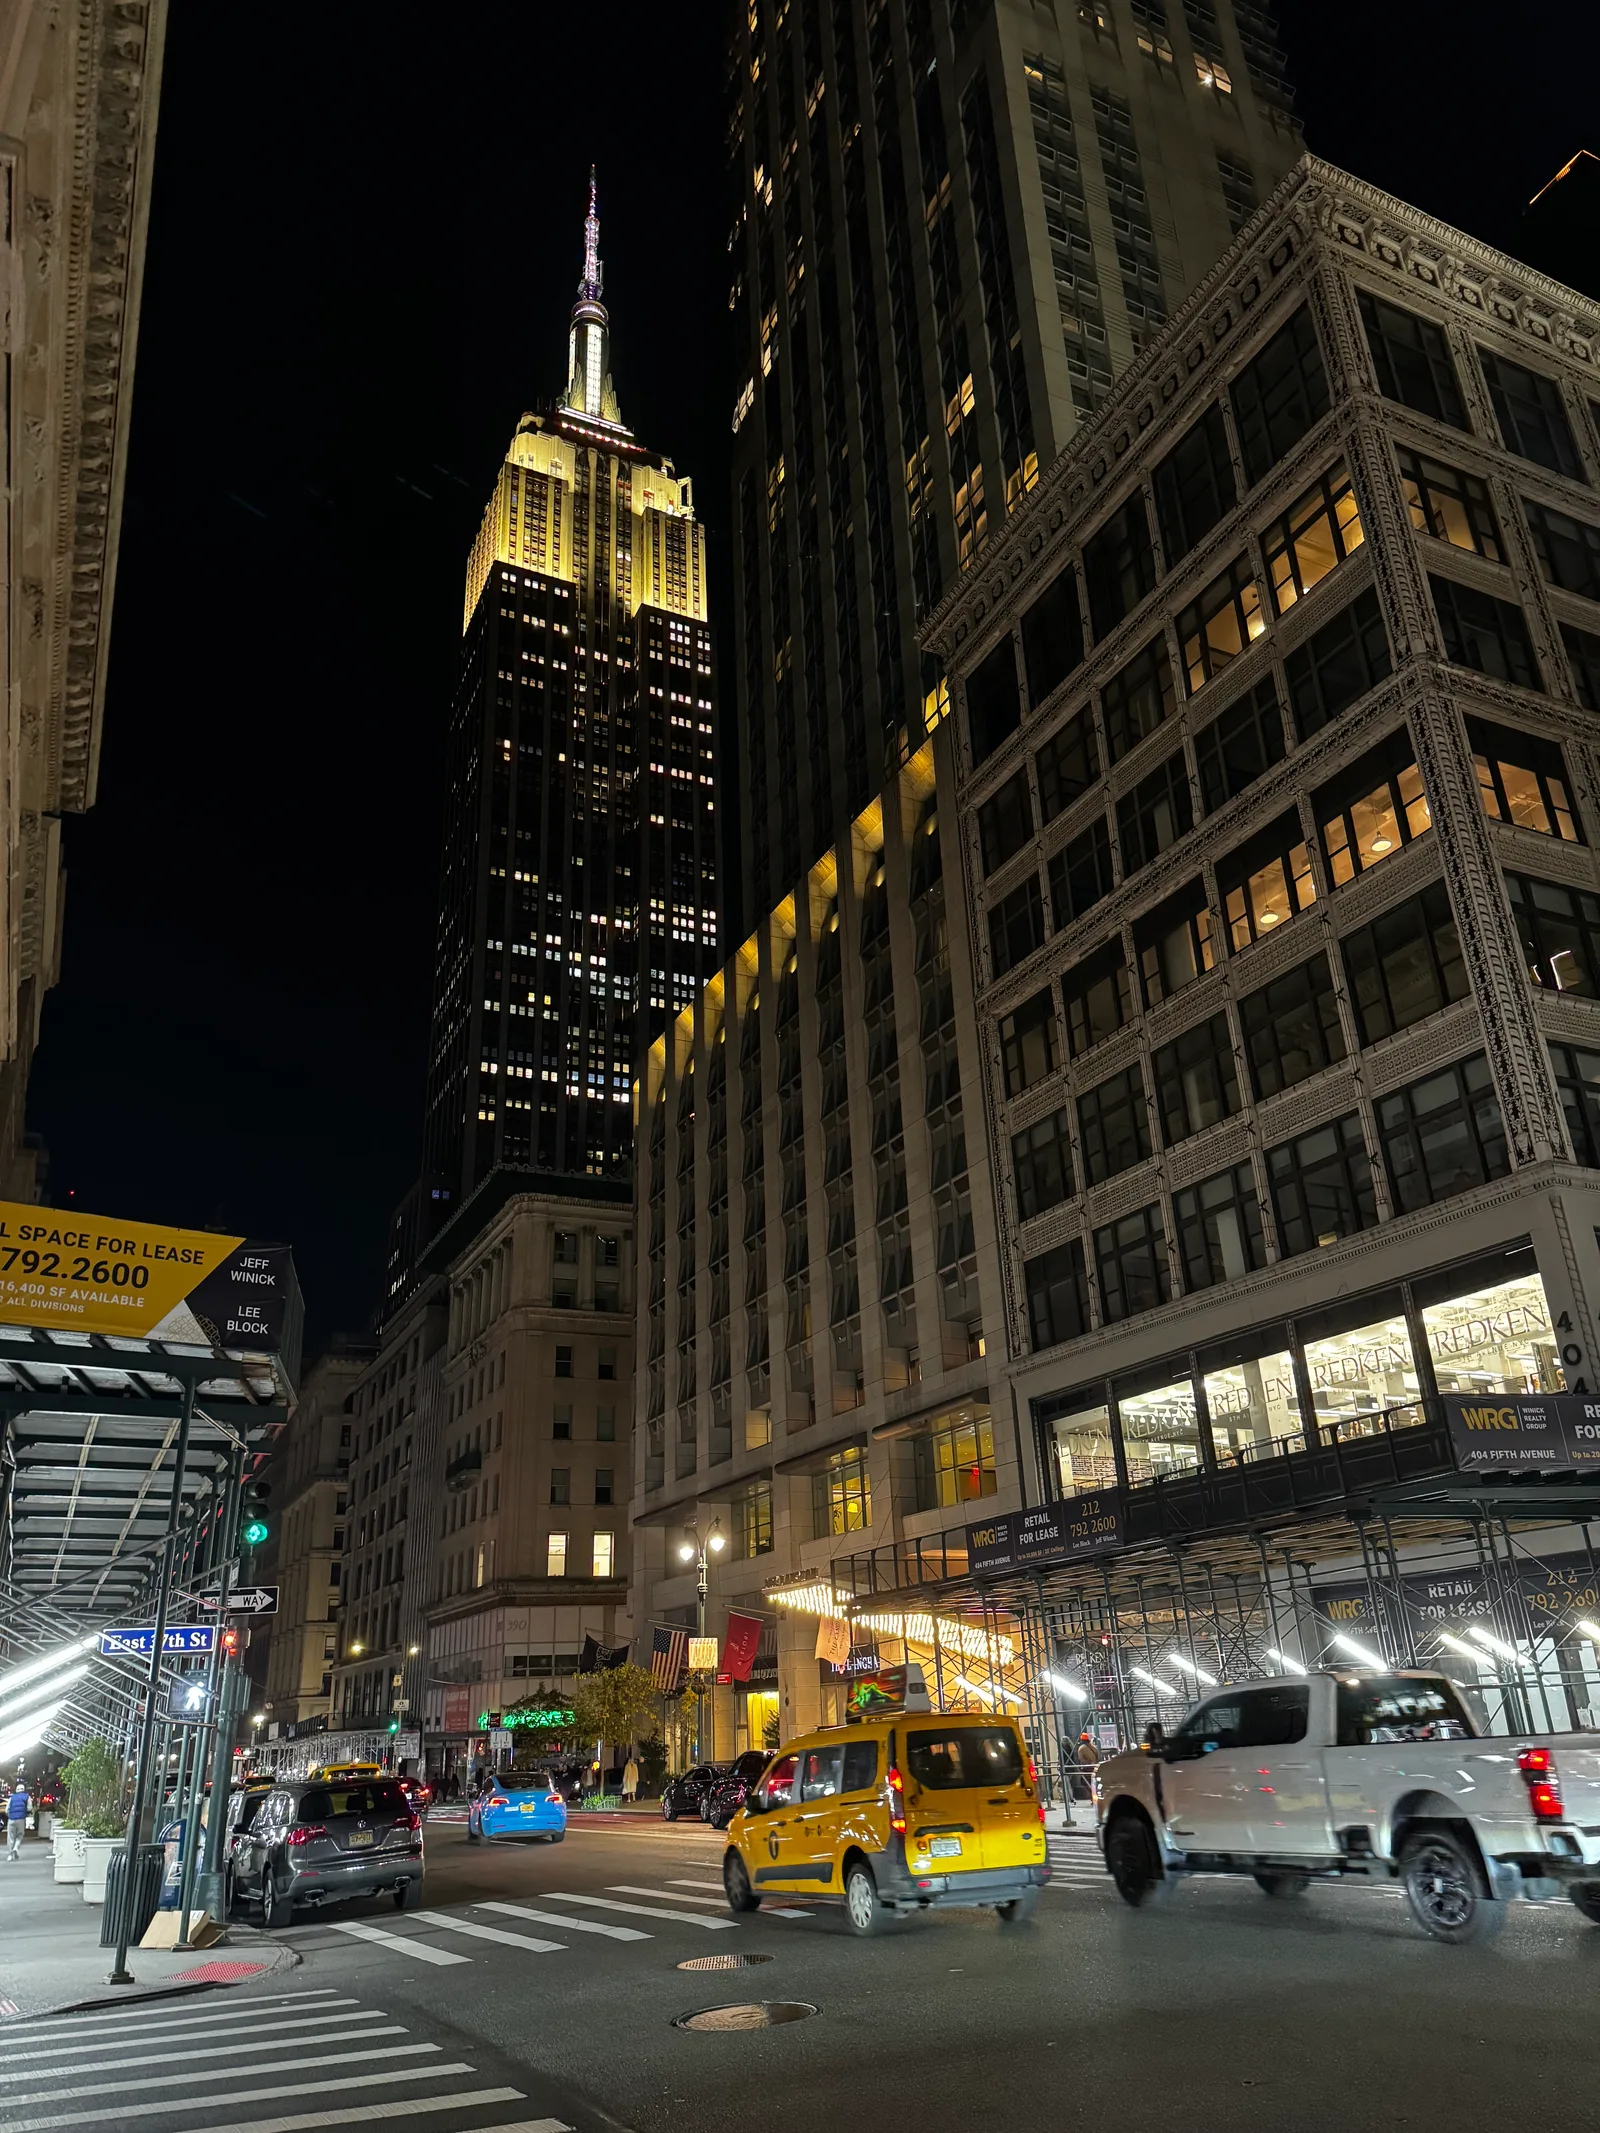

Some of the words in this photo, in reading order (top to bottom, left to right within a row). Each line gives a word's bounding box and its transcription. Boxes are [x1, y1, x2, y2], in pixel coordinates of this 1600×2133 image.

[18, 1225, 91, 1249] SPACE
[96, 1236, 136, 1255] FOR
[142, 1243, 205, 1265] LEASE
[1, 1247, 149, 1288] 792.2600
[240, 1256, 269, 1270] JEFF
[230, 1270, 276, 1286] WINICK
[0, 1281, 45, 1295] 16,400
[49, 1286, 66, 1297] SF
[70, 1289, 144, 1307] AVAILABLE
[7, 1297, 26, 1306] ALL
[30, 1299, 84, 1313] DIVISIONS
[238, 1306, 261, 1318] LEE
[227, 1320, 269, 1334] BLOCK
[1433, 1302, 1547, 1356] REDKEN
[1314, 1342, 1408, 1389] REDKEN
[1213, 1374, 1293, 1416] REDKEN
[1461, 1407, 1519, 1430] WRG
[1050, 1425, 1110, 1460] REDKEN
[1471, 1451, 1488, 1460] 404
[1490, 1450, 1517, 1459] FIFTH
[1520, 1450, 1556, 1459] AVENUE
[1572, 1451, 1582, 1459] Up
[1081, 1500, 1100, 1517] 212
[1024, 1512, 1050, 1528] RETAIL
[1070, 1522, 1088, 1537] 792
[1091, 1515, 1116, 1533] 2600
[972, 1528, 995, 1548] WRG
[1019, 1532, 1034, 1546] FOR
[1035, 1527, 1059, 1540] LEASE
[1428, 1580, 1477, 1598] RETAIL
[211, 1597, 233, 1607] OE
[243, 1595, 266, 1607] WAY
[1326, 1598, 1366, 1620] WRG
[1527, 1593, 1559, 1611] 792
[1420, 1605, 1446, 1620] FOR
[507, 1619, 527, 1631] 390
[109, 1635, 146, 1650] East
[190, 1632, 207, 1648] St
[1076, 1651, 1106, 1665] REKEN
